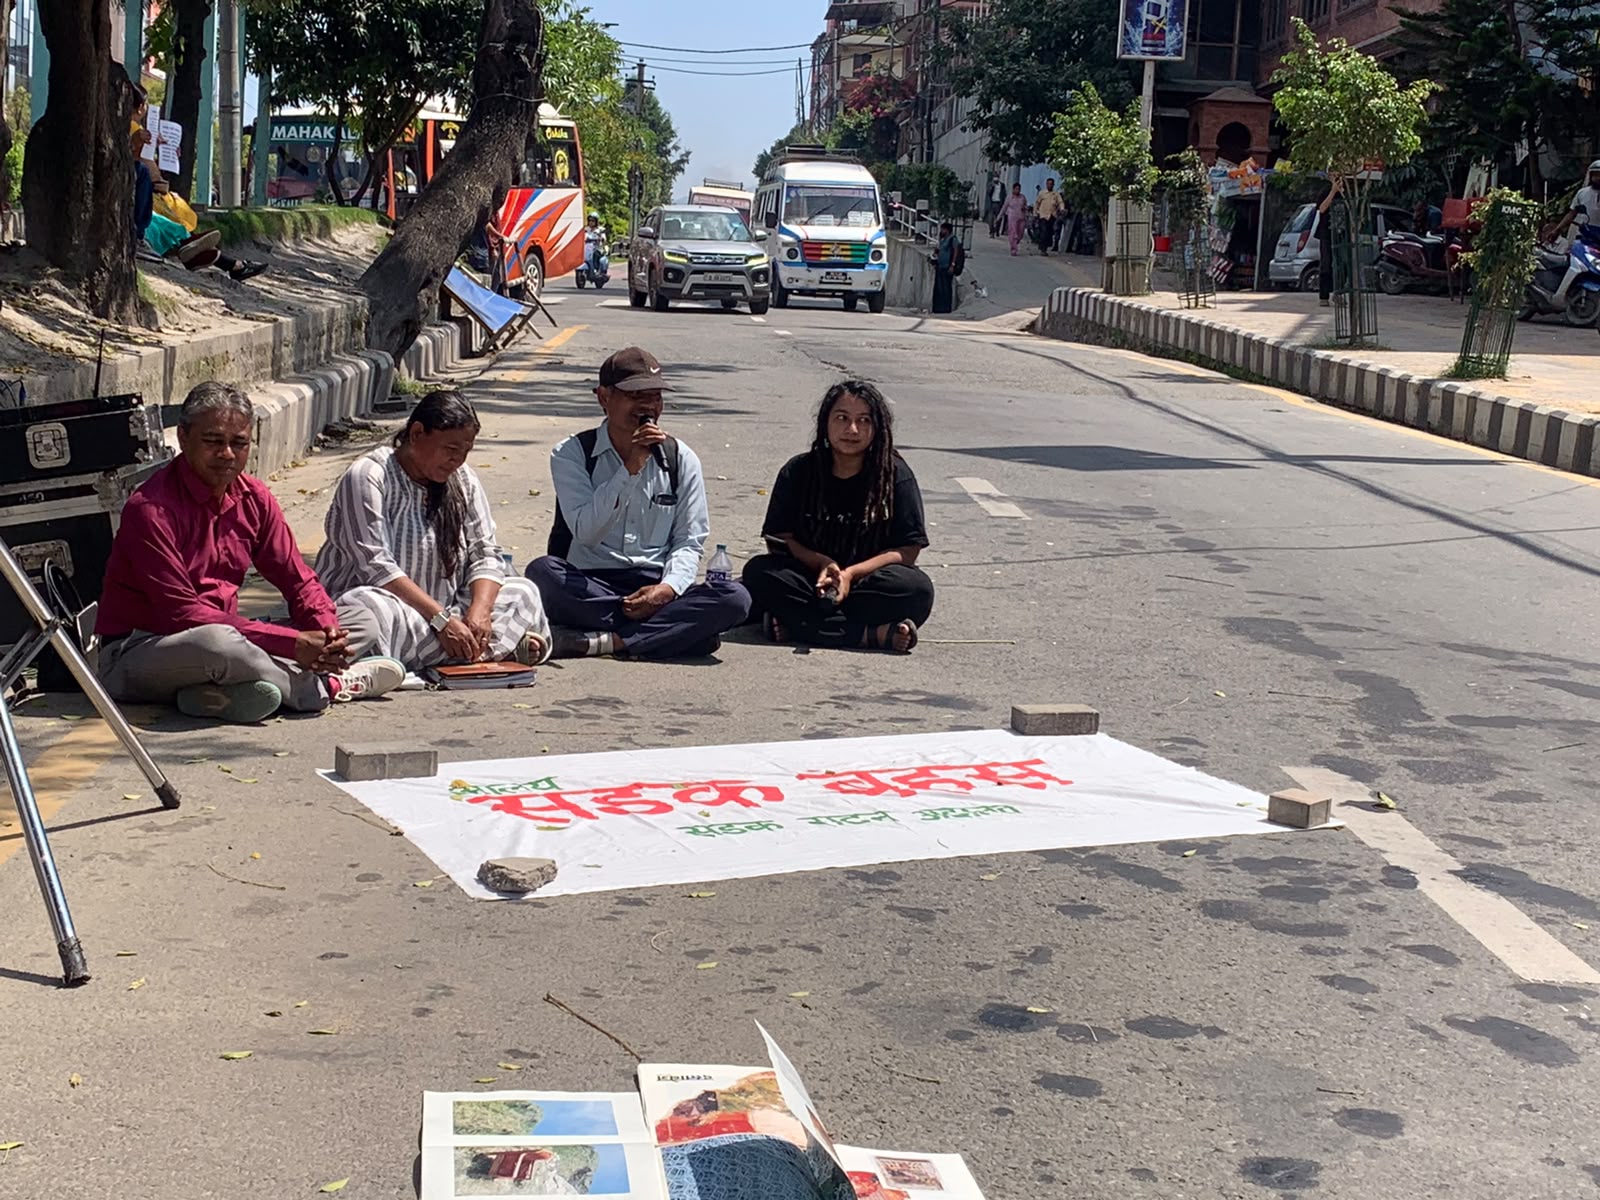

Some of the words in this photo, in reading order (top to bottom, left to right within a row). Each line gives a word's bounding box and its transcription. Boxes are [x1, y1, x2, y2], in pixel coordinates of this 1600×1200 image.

[1501, 204, 1522, 216] KMC
[465, 779, 785, 824] सडक
[795, 758, 1074, 798] बहस
[676, 820, 784, 838] सडक
